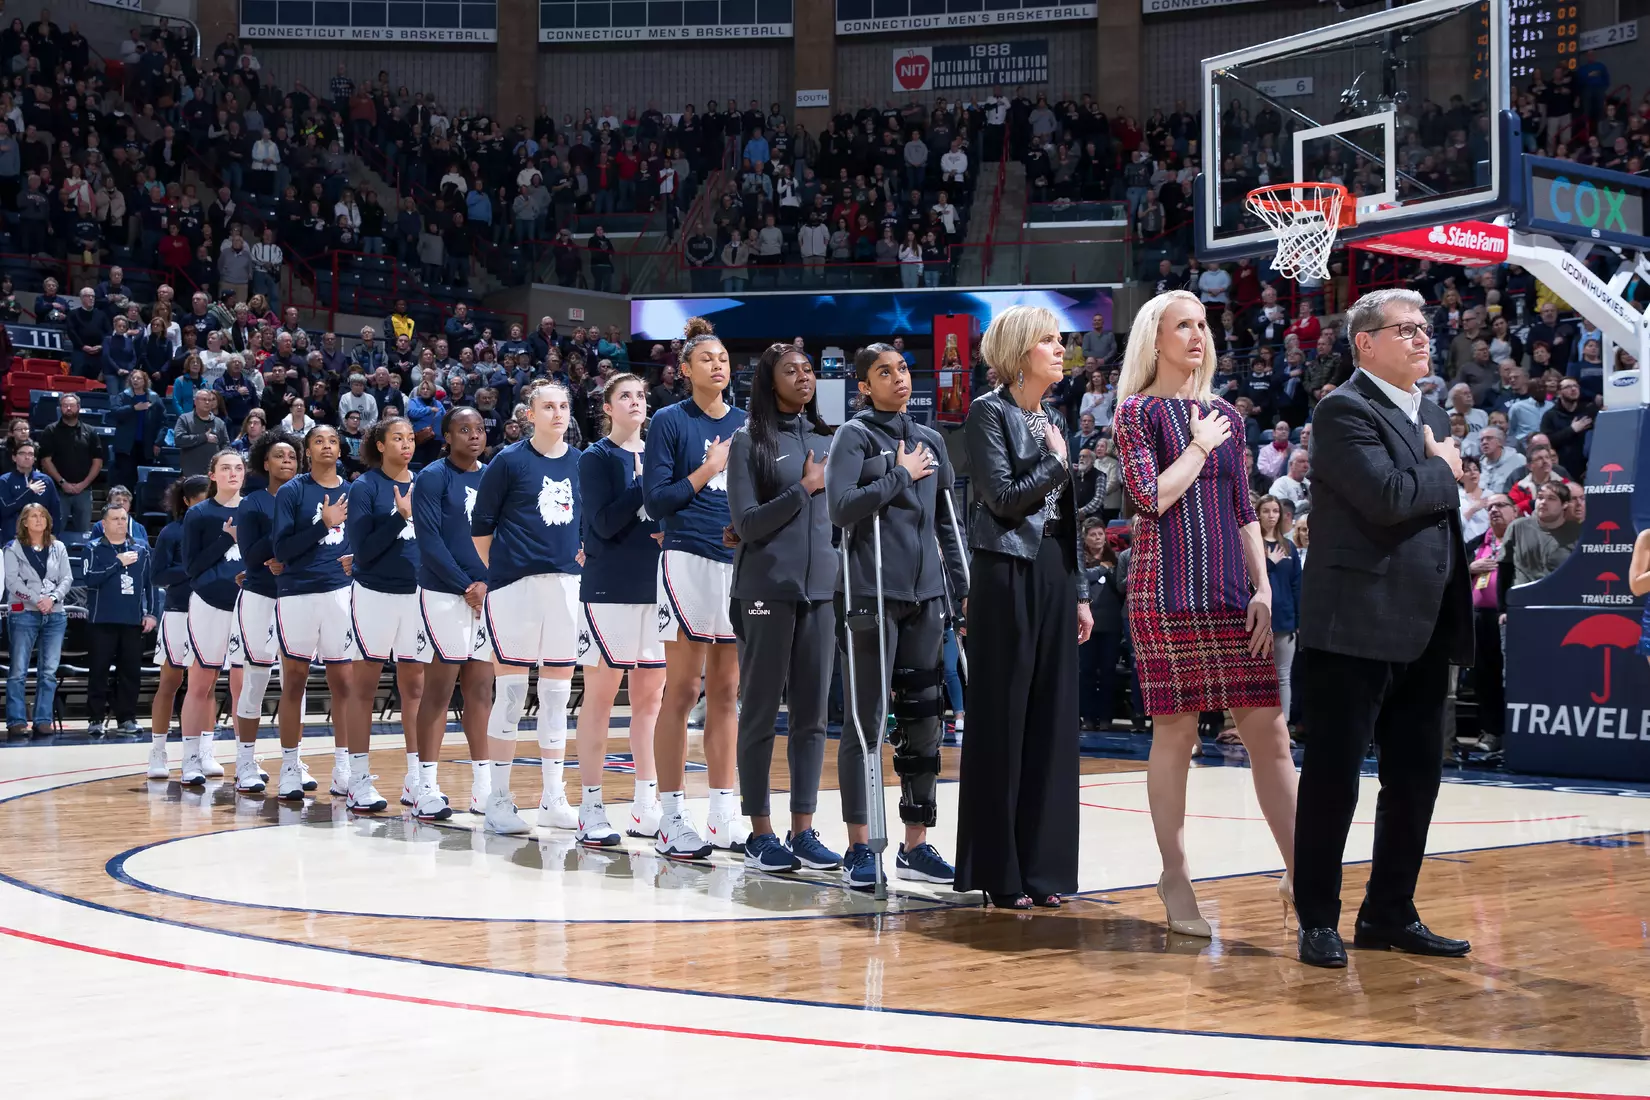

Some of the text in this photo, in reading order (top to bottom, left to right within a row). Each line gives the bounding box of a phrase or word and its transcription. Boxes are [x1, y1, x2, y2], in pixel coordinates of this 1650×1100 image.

[844, 7, 1090, 32] CONNECTICUT MEN'S BASKETBALL
[248, 27, 490, 41] CONNECTICUT MEN'S BASKETBALL
[547, 26, 785, 40] CONNECTICUT MEN'S BASKETBALL
[1608, 24, 1636, 42] 213
[969, 43, 1011, 57] 1988
[901, 63, 925, 77] NIT
[933, 55, 1047, 73] NATIONAL INVITATION
[934, 68, 1048, 88] TOURNAMENT CHAMPION
[1296, 80, 1306, 92] 6
[797, 94, 828, 102] SOUTH
[1551, 176, 1627, 232] COX
[30, 330, 61, 349] 111
[1584, 484, 1635, 494] TRAVELERS
[1581, 544, 1633, 553] TRAVELERS
[1581, 594, 1634, 604] TRAVELERS
